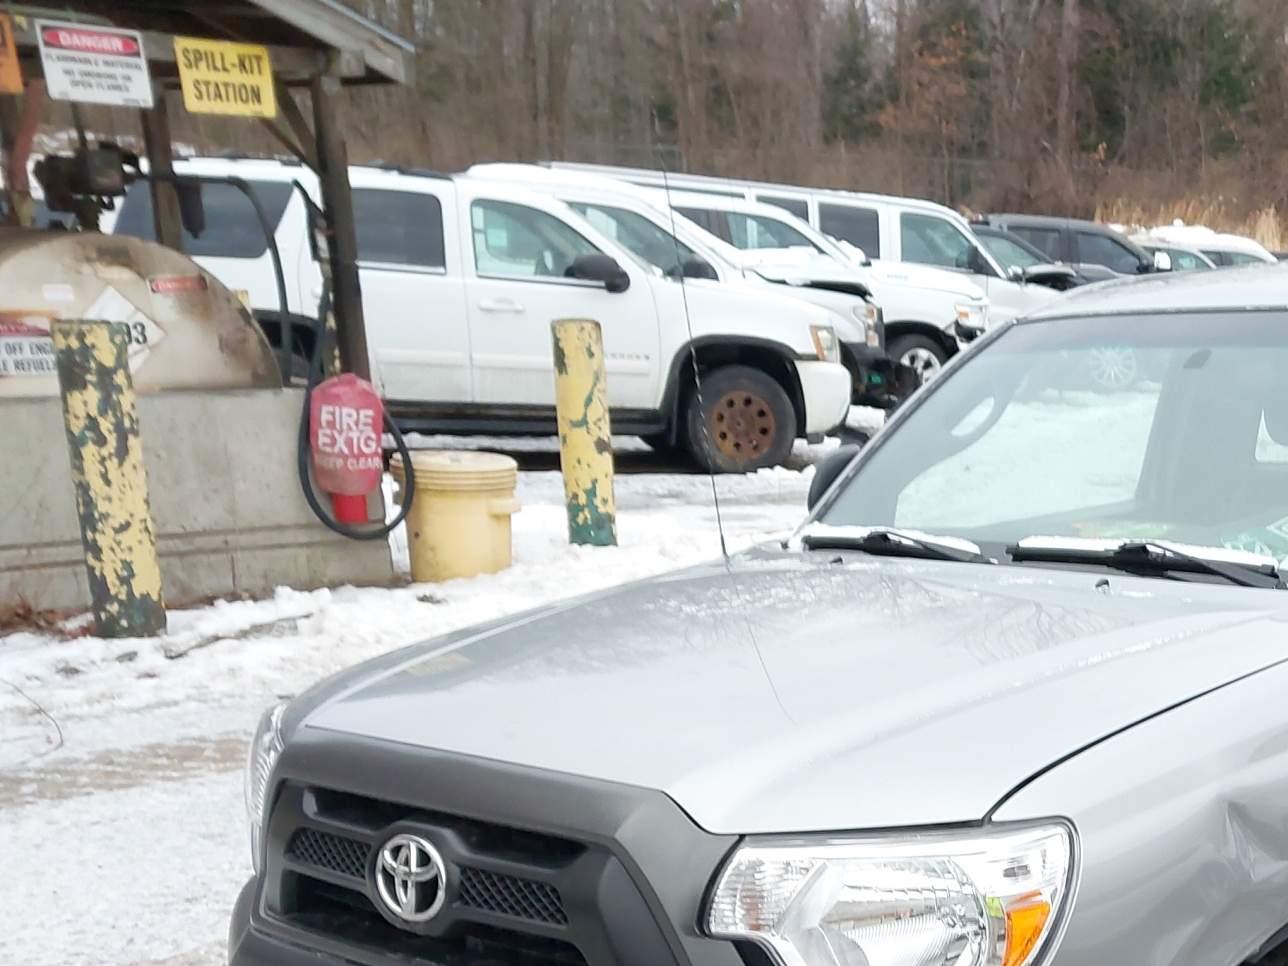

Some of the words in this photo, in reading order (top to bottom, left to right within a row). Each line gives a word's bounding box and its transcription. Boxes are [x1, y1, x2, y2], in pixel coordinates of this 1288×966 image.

[59, 31, 123, 52] DANGER
[182, 47, 263, 75] SPILL-KIT
[193, 79, 262, 105] STATION
[5, 342, 23, 355] OFF
[320, 404, 375, 432] FIRE
[317, 428, 382, 455] EXTG.
